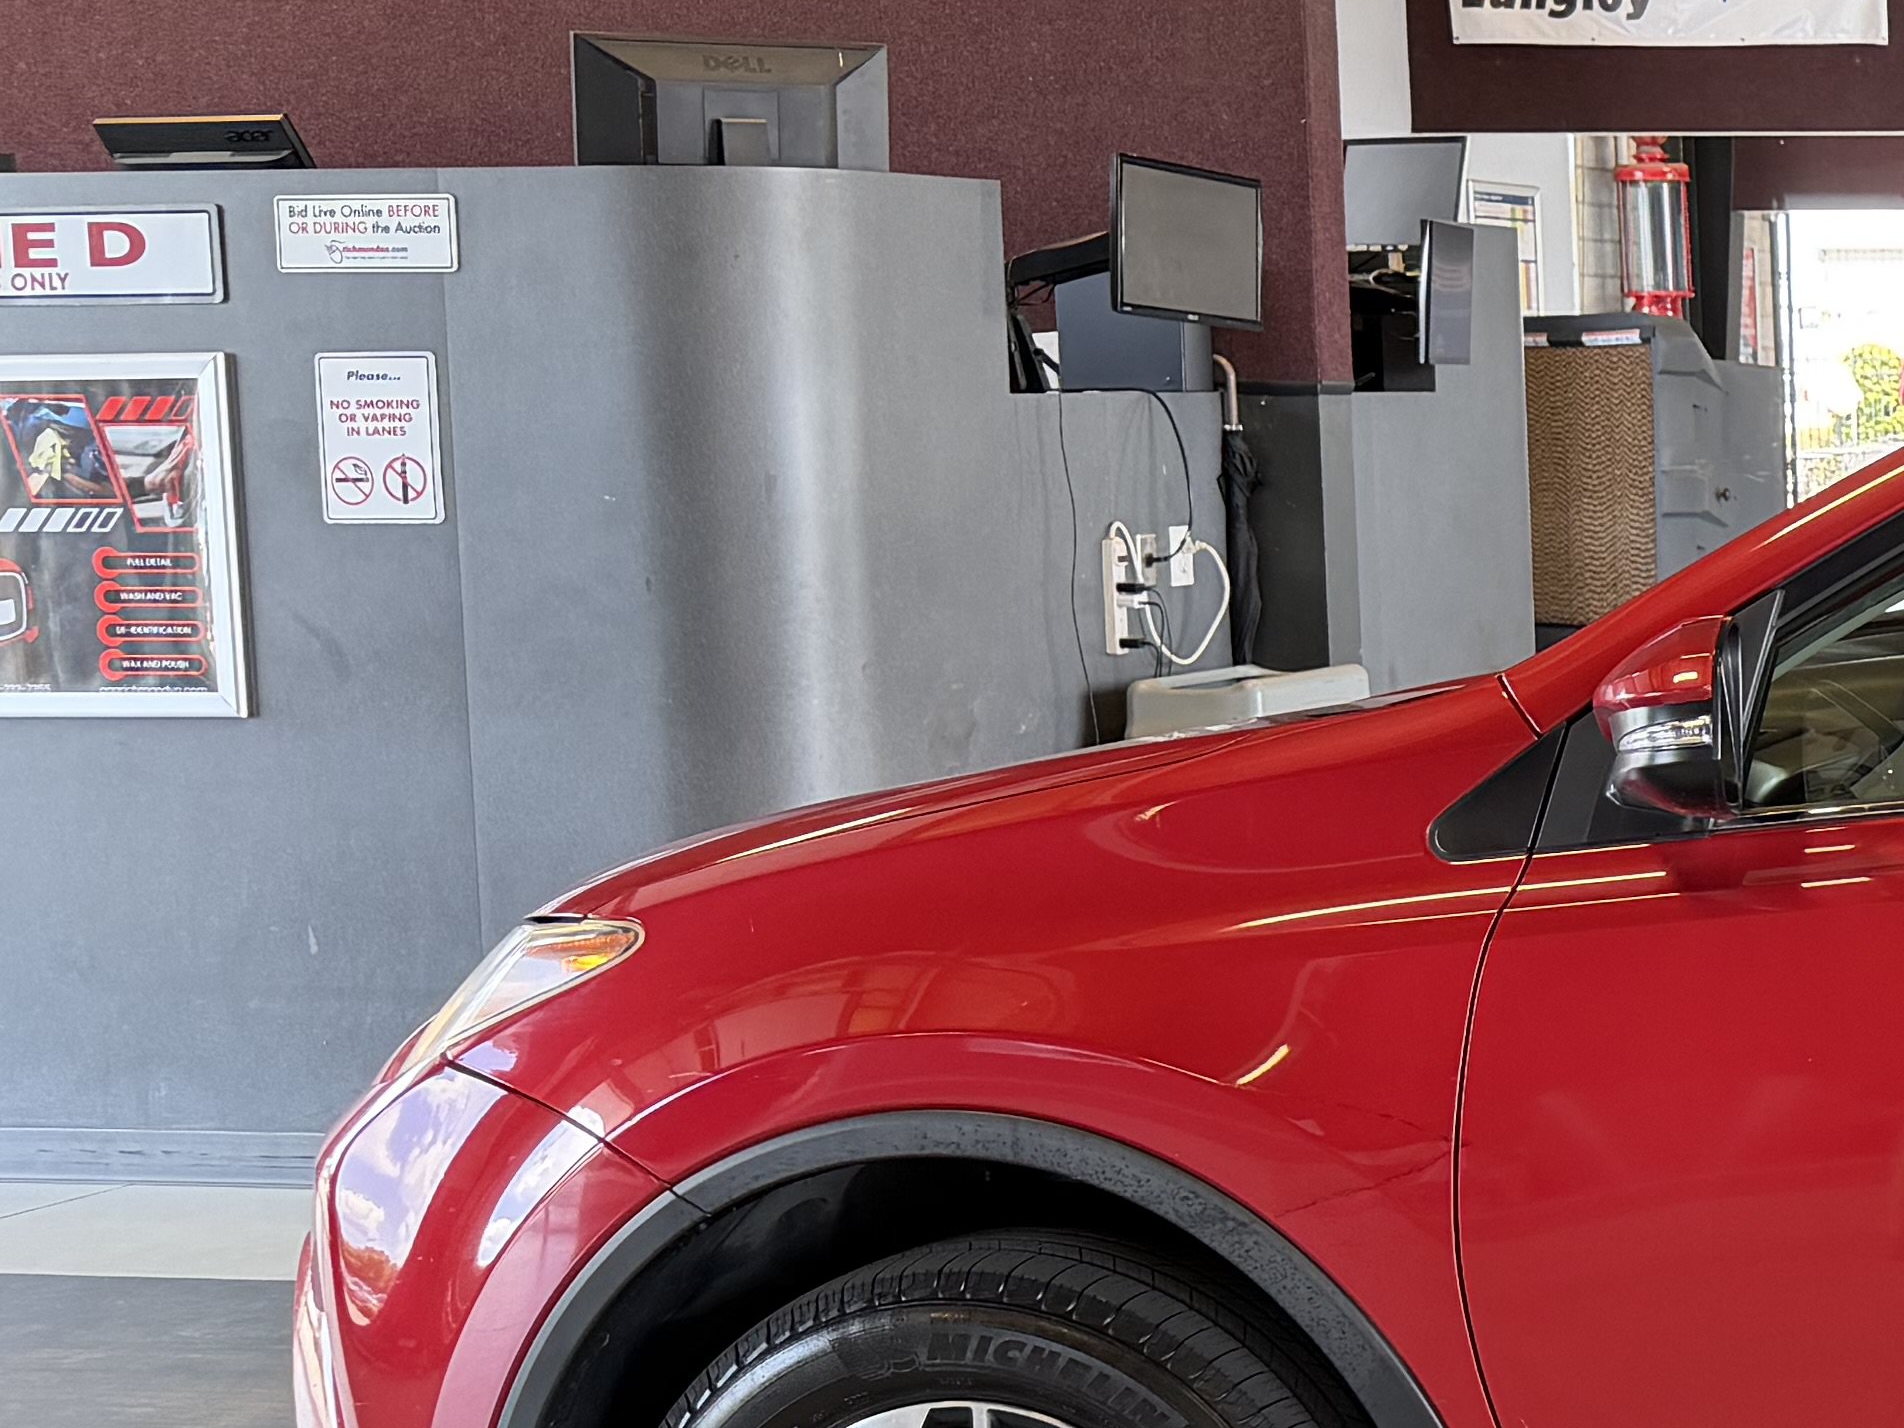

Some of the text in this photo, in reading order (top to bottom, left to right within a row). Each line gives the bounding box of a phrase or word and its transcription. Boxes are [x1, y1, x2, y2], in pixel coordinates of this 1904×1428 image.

[288, 204, 440, 219] Bid Live Online BEFORE
[288, 221, 441, 235] OR DURING the Auction
[11, 271, 70, 292] ONLY
[346, 370, 402, 382] Please...
[329, 398, 421, 410] NO SMOKING
[338, 412, 414, 424] OR VAPING
[346, 425, 408, 437] IN LANES
